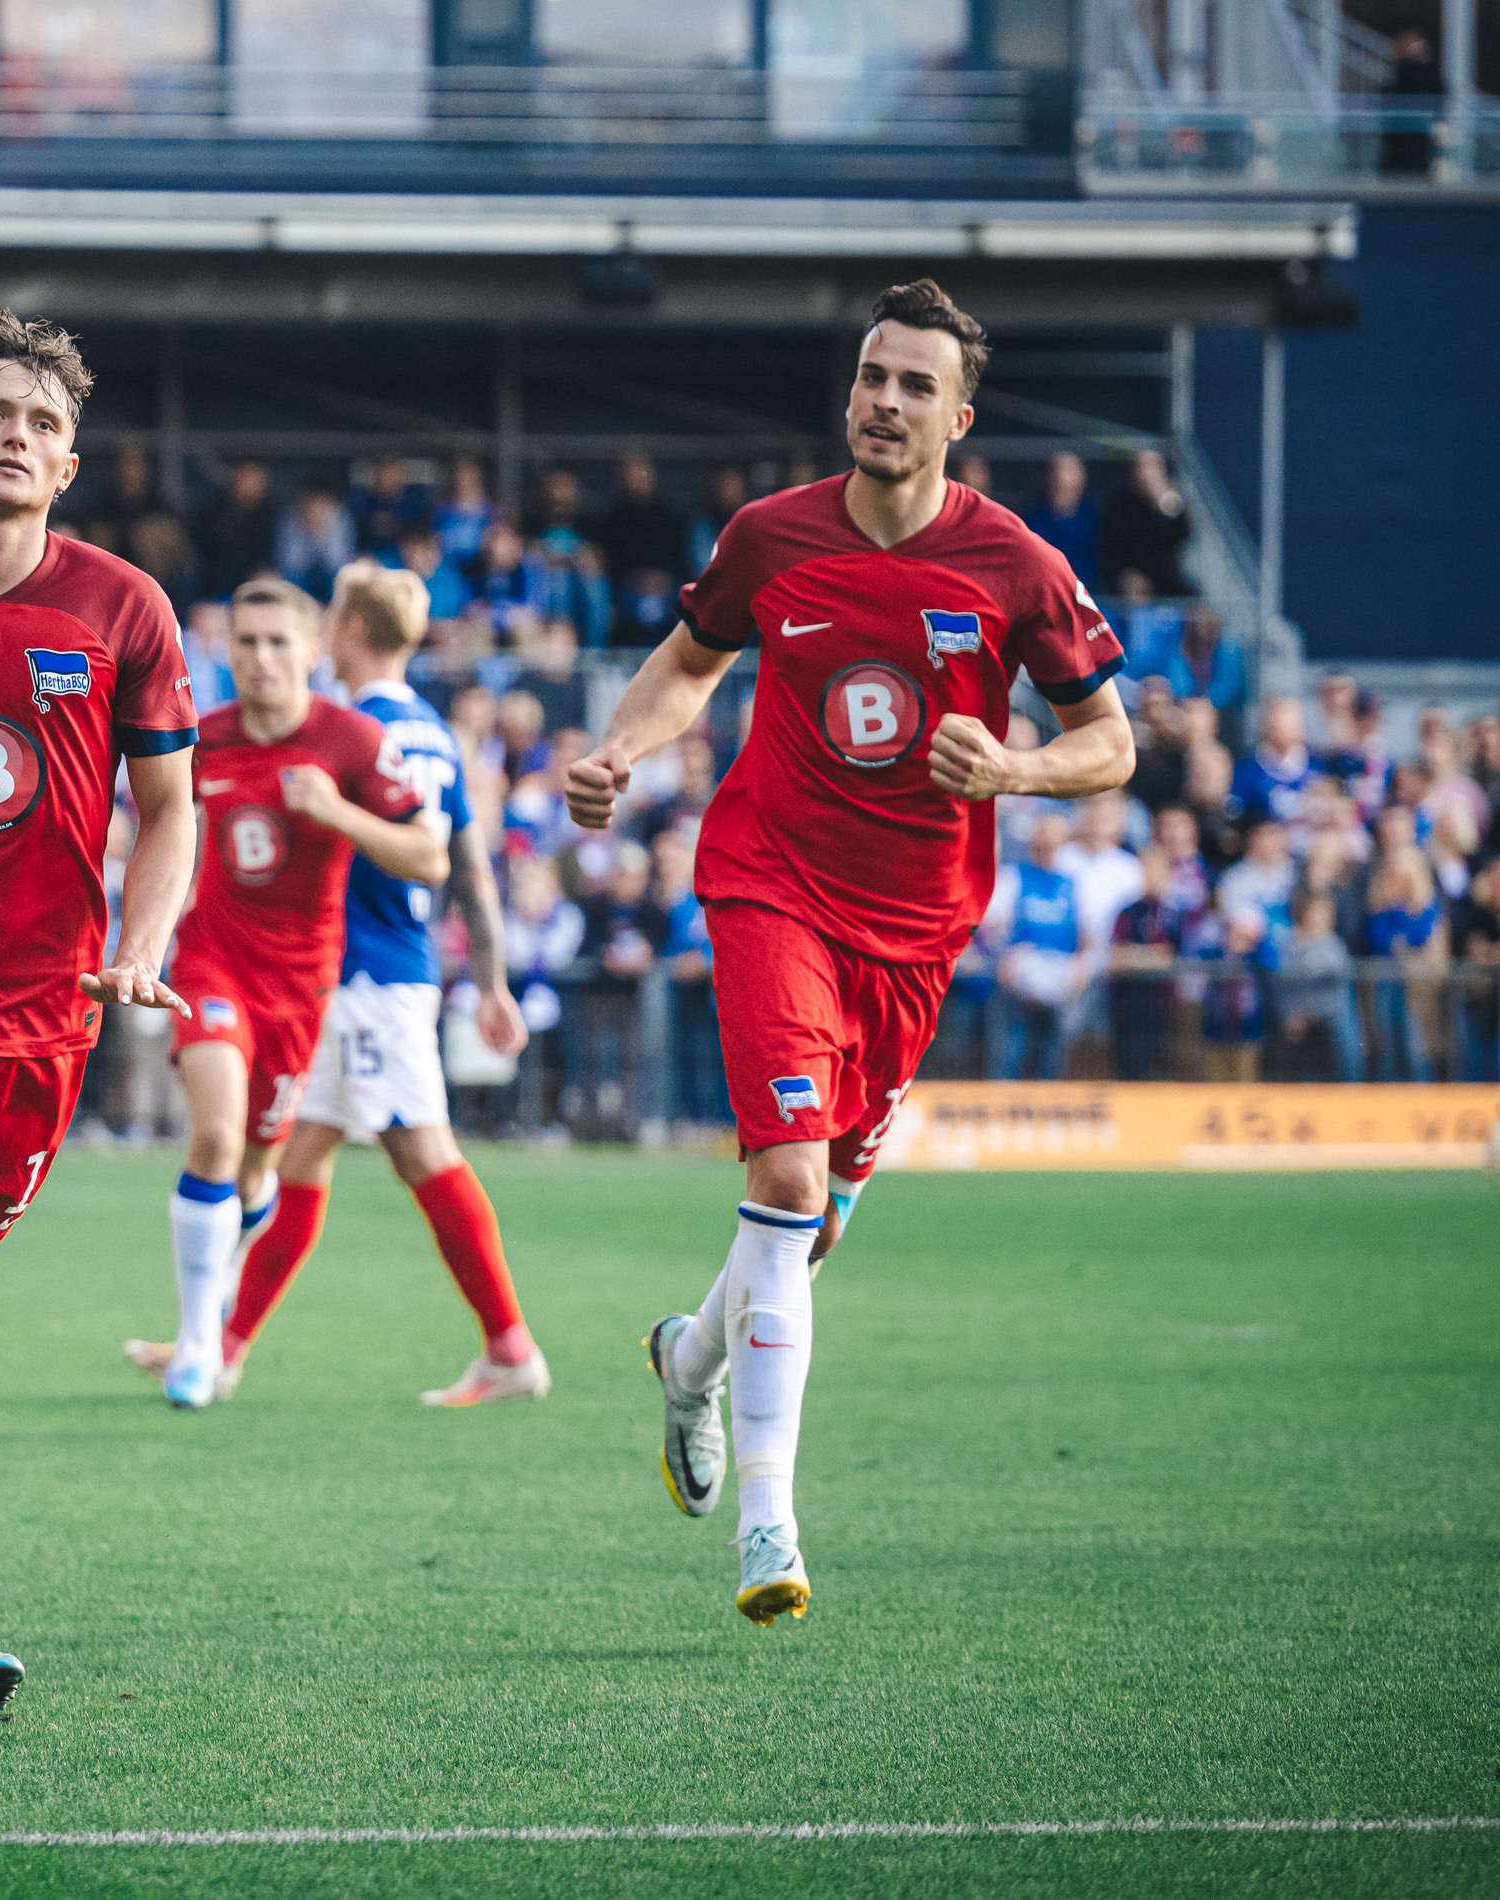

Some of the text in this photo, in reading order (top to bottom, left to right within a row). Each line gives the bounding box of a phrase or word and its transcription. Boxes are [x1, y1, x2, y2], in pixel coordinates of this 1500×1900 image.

[845, 682, 898, 746] B
[233, 819, 276, 870] B
[340, 1028, 384, 1076] 15
